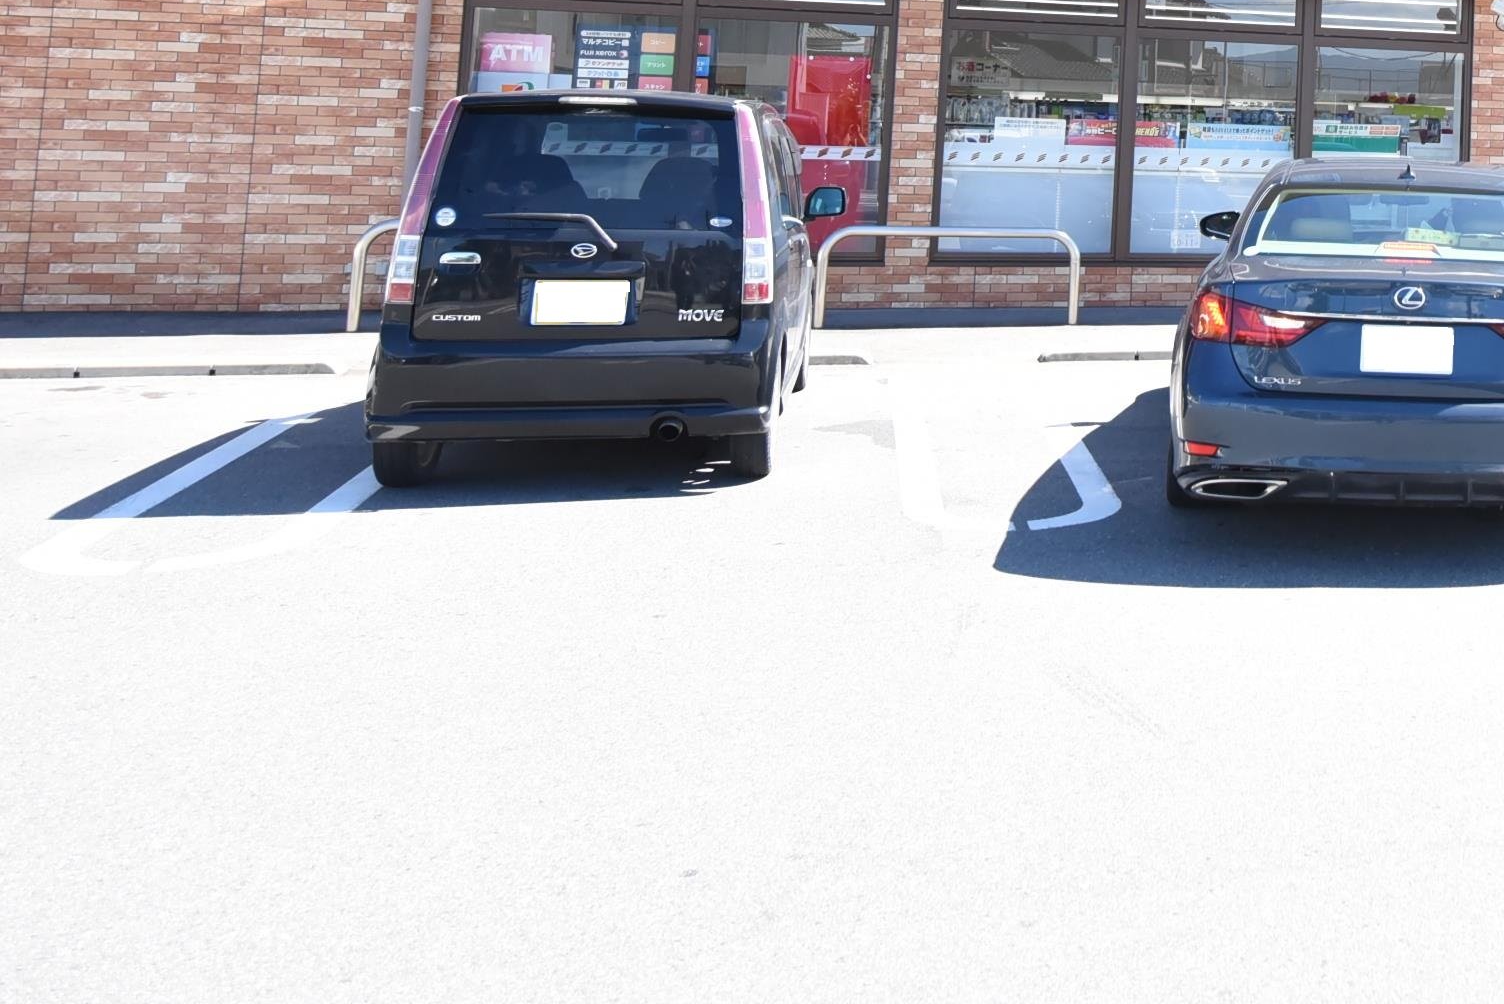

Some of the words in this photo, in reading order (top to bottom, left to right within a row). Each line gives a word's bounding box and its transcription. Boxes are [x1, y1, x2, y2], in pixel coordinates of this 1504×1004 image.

[582, 37, 629, 47] マルチコピー
[488, 42, 543, 62] ATM
[432, 314, 481, 322] CUSTOM
[678, 309, 724, 323] MOVE
[1253, 375, 1302, 386] LEXUS
